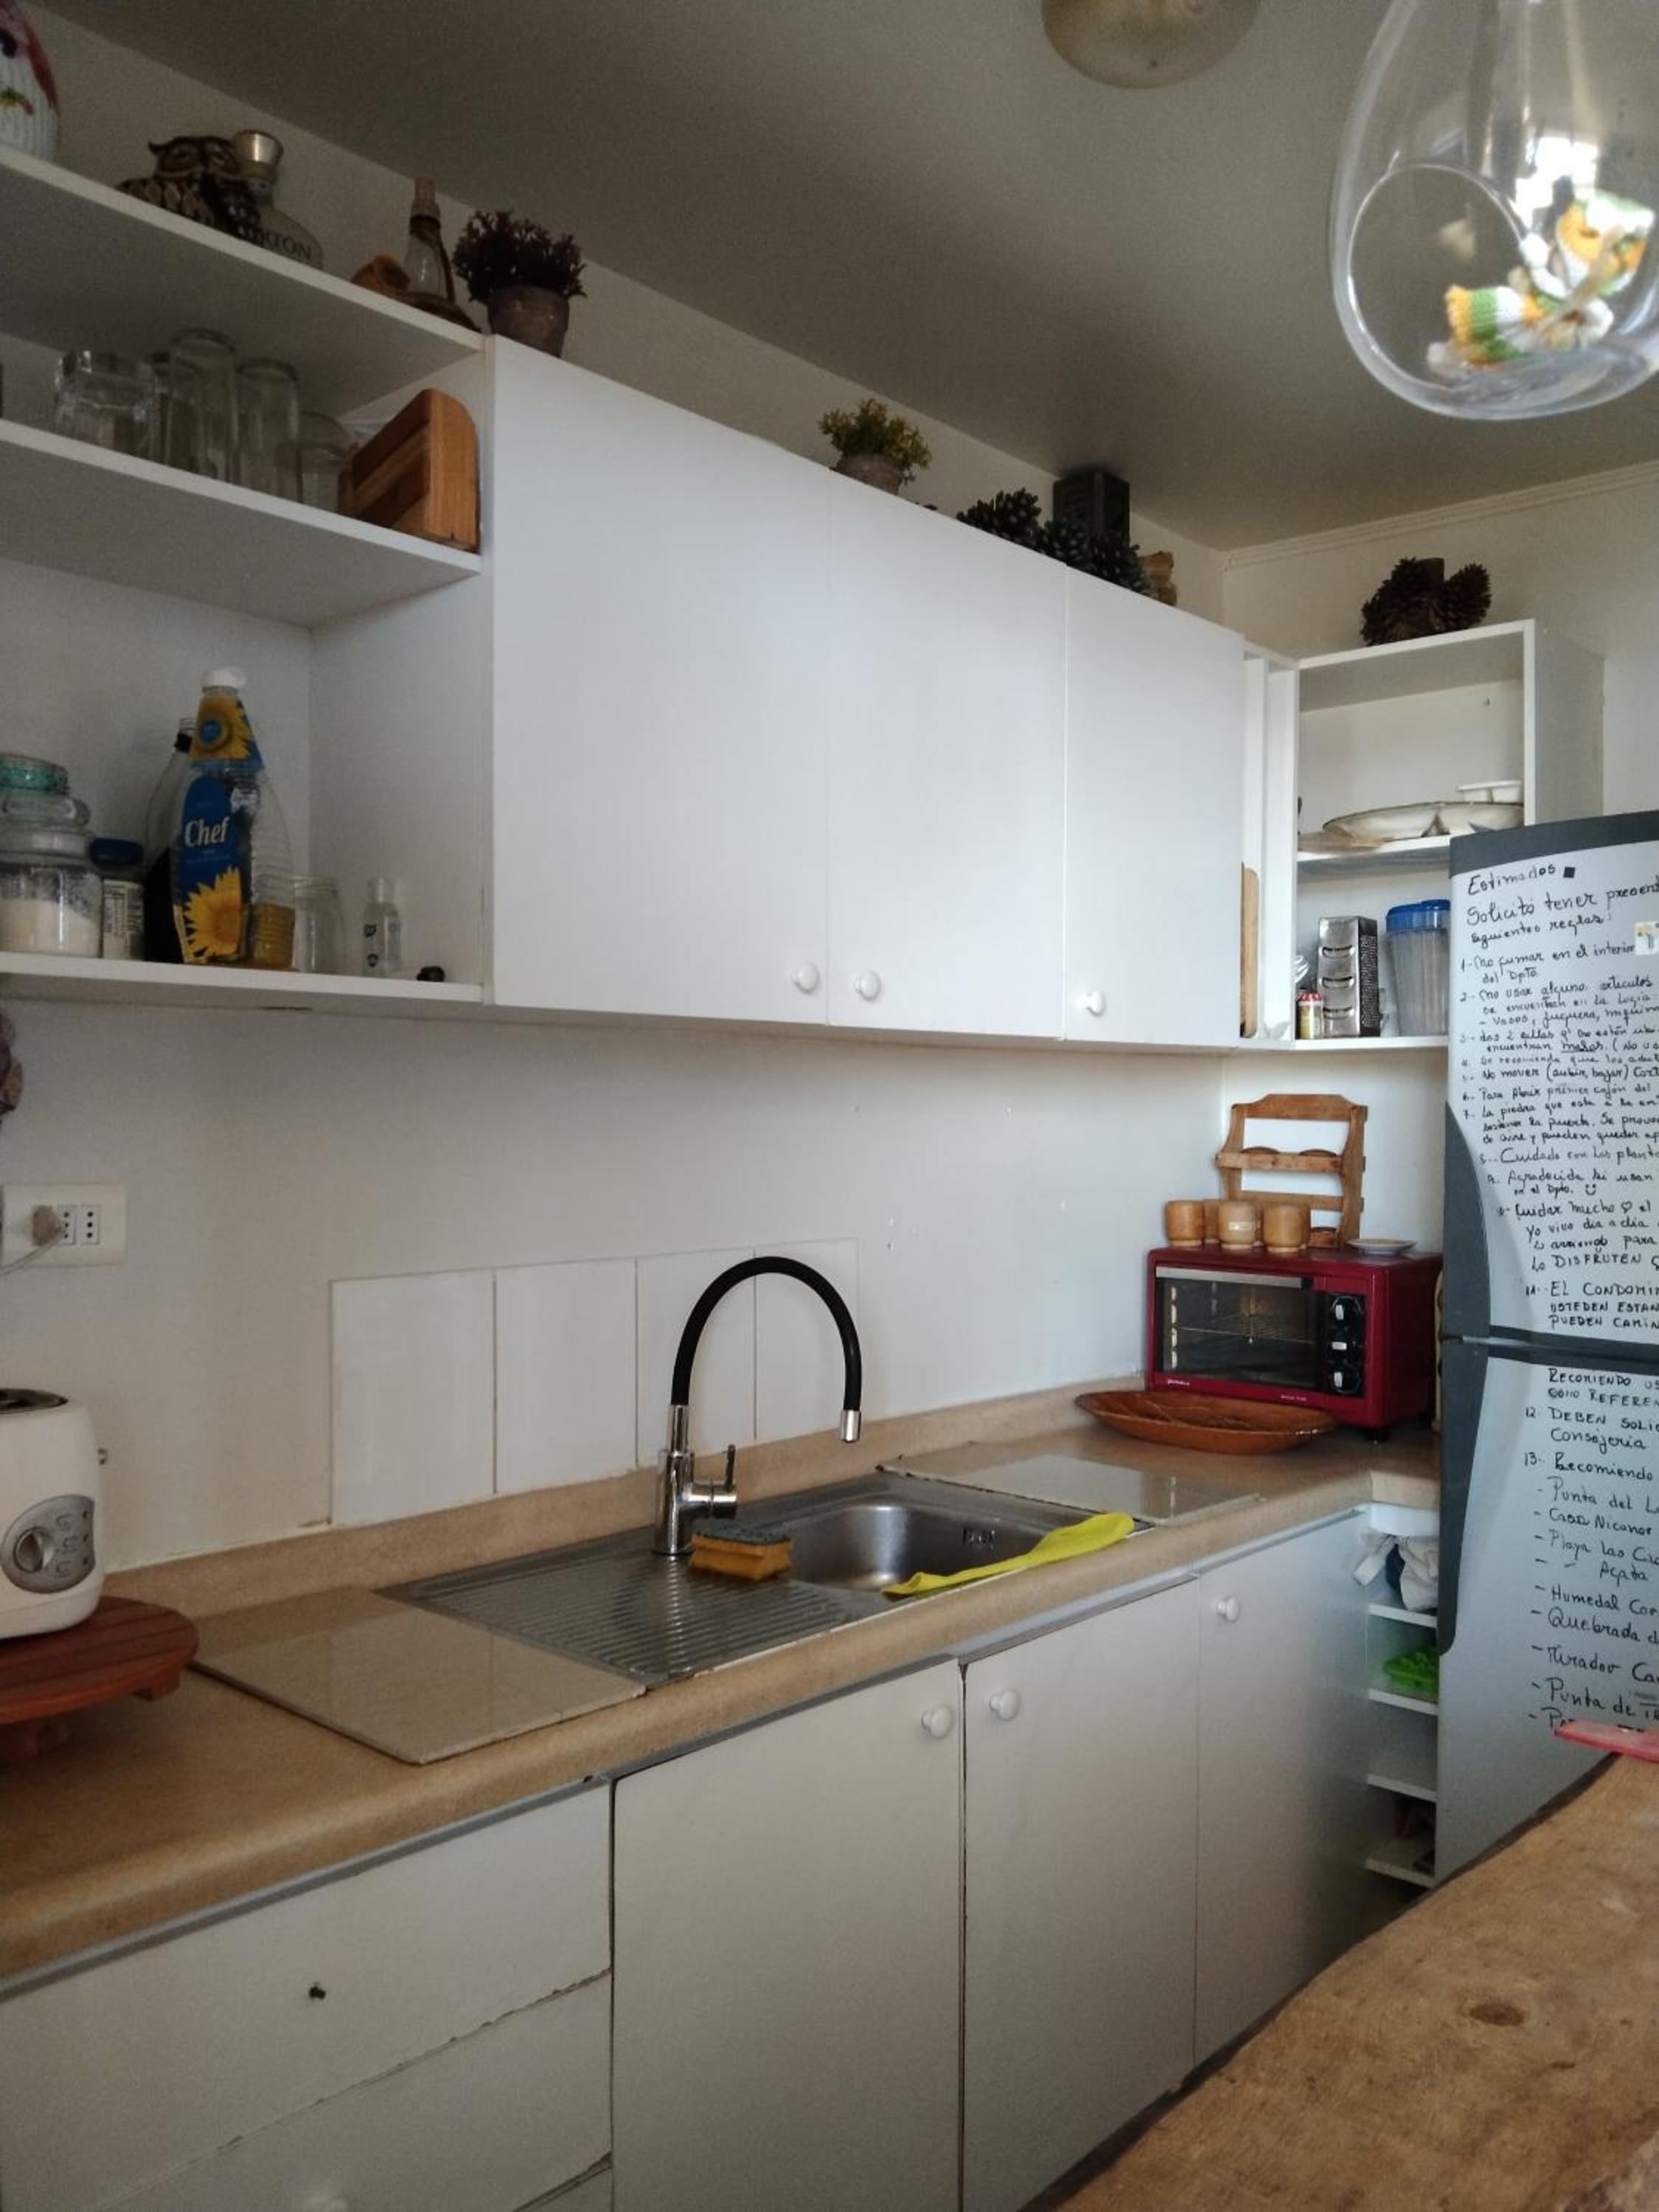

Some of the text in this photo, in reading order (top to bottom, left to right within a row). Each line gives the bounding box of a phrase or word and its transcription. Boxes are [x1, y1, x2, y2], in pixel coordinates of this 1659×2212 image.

[184, 816, 229, 848] Chef
[1545, 892, 1598, 911] tener
[1499, 953, 1544, 976] fumar
[1552, 951, 1571, 960] en
[1576, 944, 1590, 958] el
[1506, 988, 1533, 998] usar
[1483, 1069, 1496, 1080] No
[1635, 1082, 1651, 1093] del
[1500, 1102, 1537, 1120] piedra
[1545, 1101, 1562, 1116] que
[1600, 1110, 1615, 1125] Se
[1542, 1129, 1590, 1145] pueden
[1596, 1129, 1640, 1145] quedar
[1500, 1146, 1560, 1164] Cuidado
[1548, 1222, 1574, 1234] vivo
[1608, 1220, 1617, 1228] a
[1551, 1253, 1642, 1269] DISFRUTEN
[1548, 1315, 1603, 1330] PUEDEN
[1548, 1368, 1632, 1387] RECOMIENDO
[1547, 1405, 1607, 1425] DEBEN
[1554, 1452, 1653, 1481] Recomiendo
[1545, 1475, 1598, 1505] Punta
[1609, 1493, 1633, 1510] del
[1595, 1514, 1653, 1536] Nicanor
[1548, 1528, 1592, 1561] Playa
[1551, 1584, 1621, 1611] Humedal
[1547, 1606, 1641, 1642] Quebrada
[1545, 1676, 1606, 1711] Punta
[1612, 1694, 1636, 1717] de
